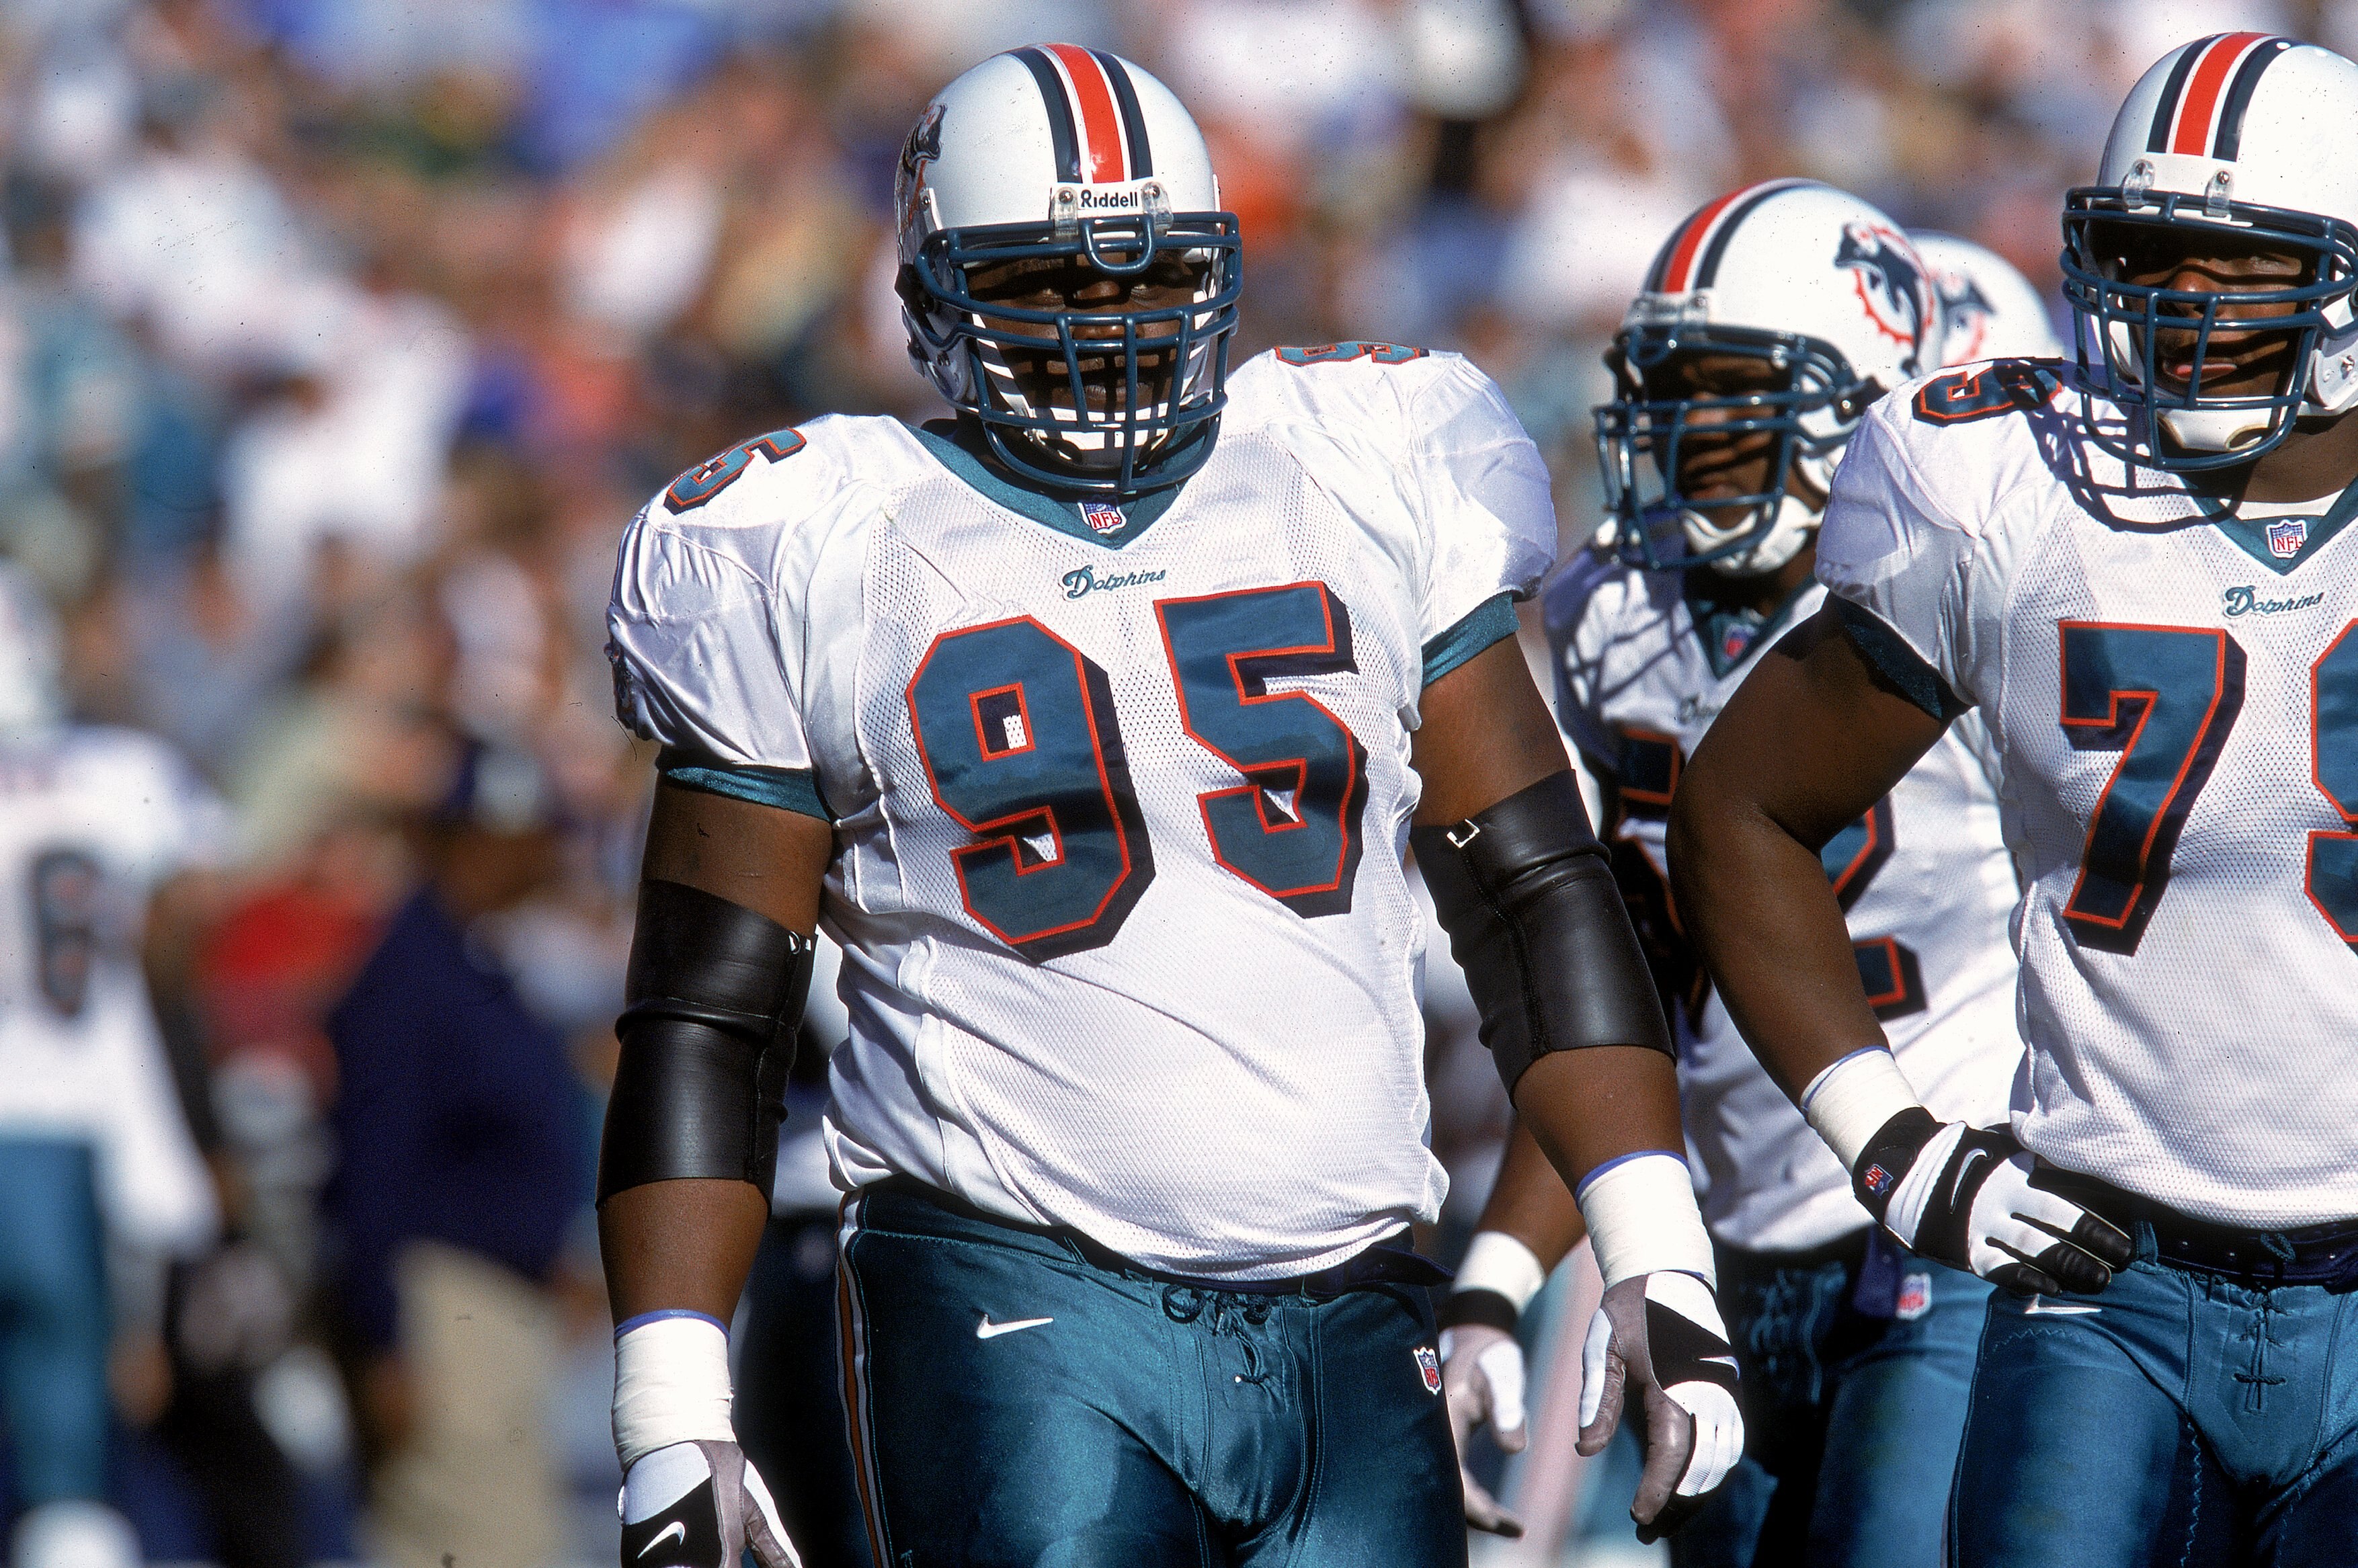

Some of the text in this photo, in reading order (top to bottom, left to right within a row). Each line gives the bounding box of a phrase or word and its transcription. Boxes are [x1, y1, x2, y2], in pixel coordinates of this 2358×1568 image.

[1080, 189, 1138, 208] Riddell
[1089, 511, 1121, 528] NFL
[2276, 536, 2304, 551] NFL
[1062, 564, 1166, 600] Dolphins
[2225, 585, 2325, 616] Dolphins
[905, 579, 1369, 966] 95
[2058, 620, 2358, 957] 7
